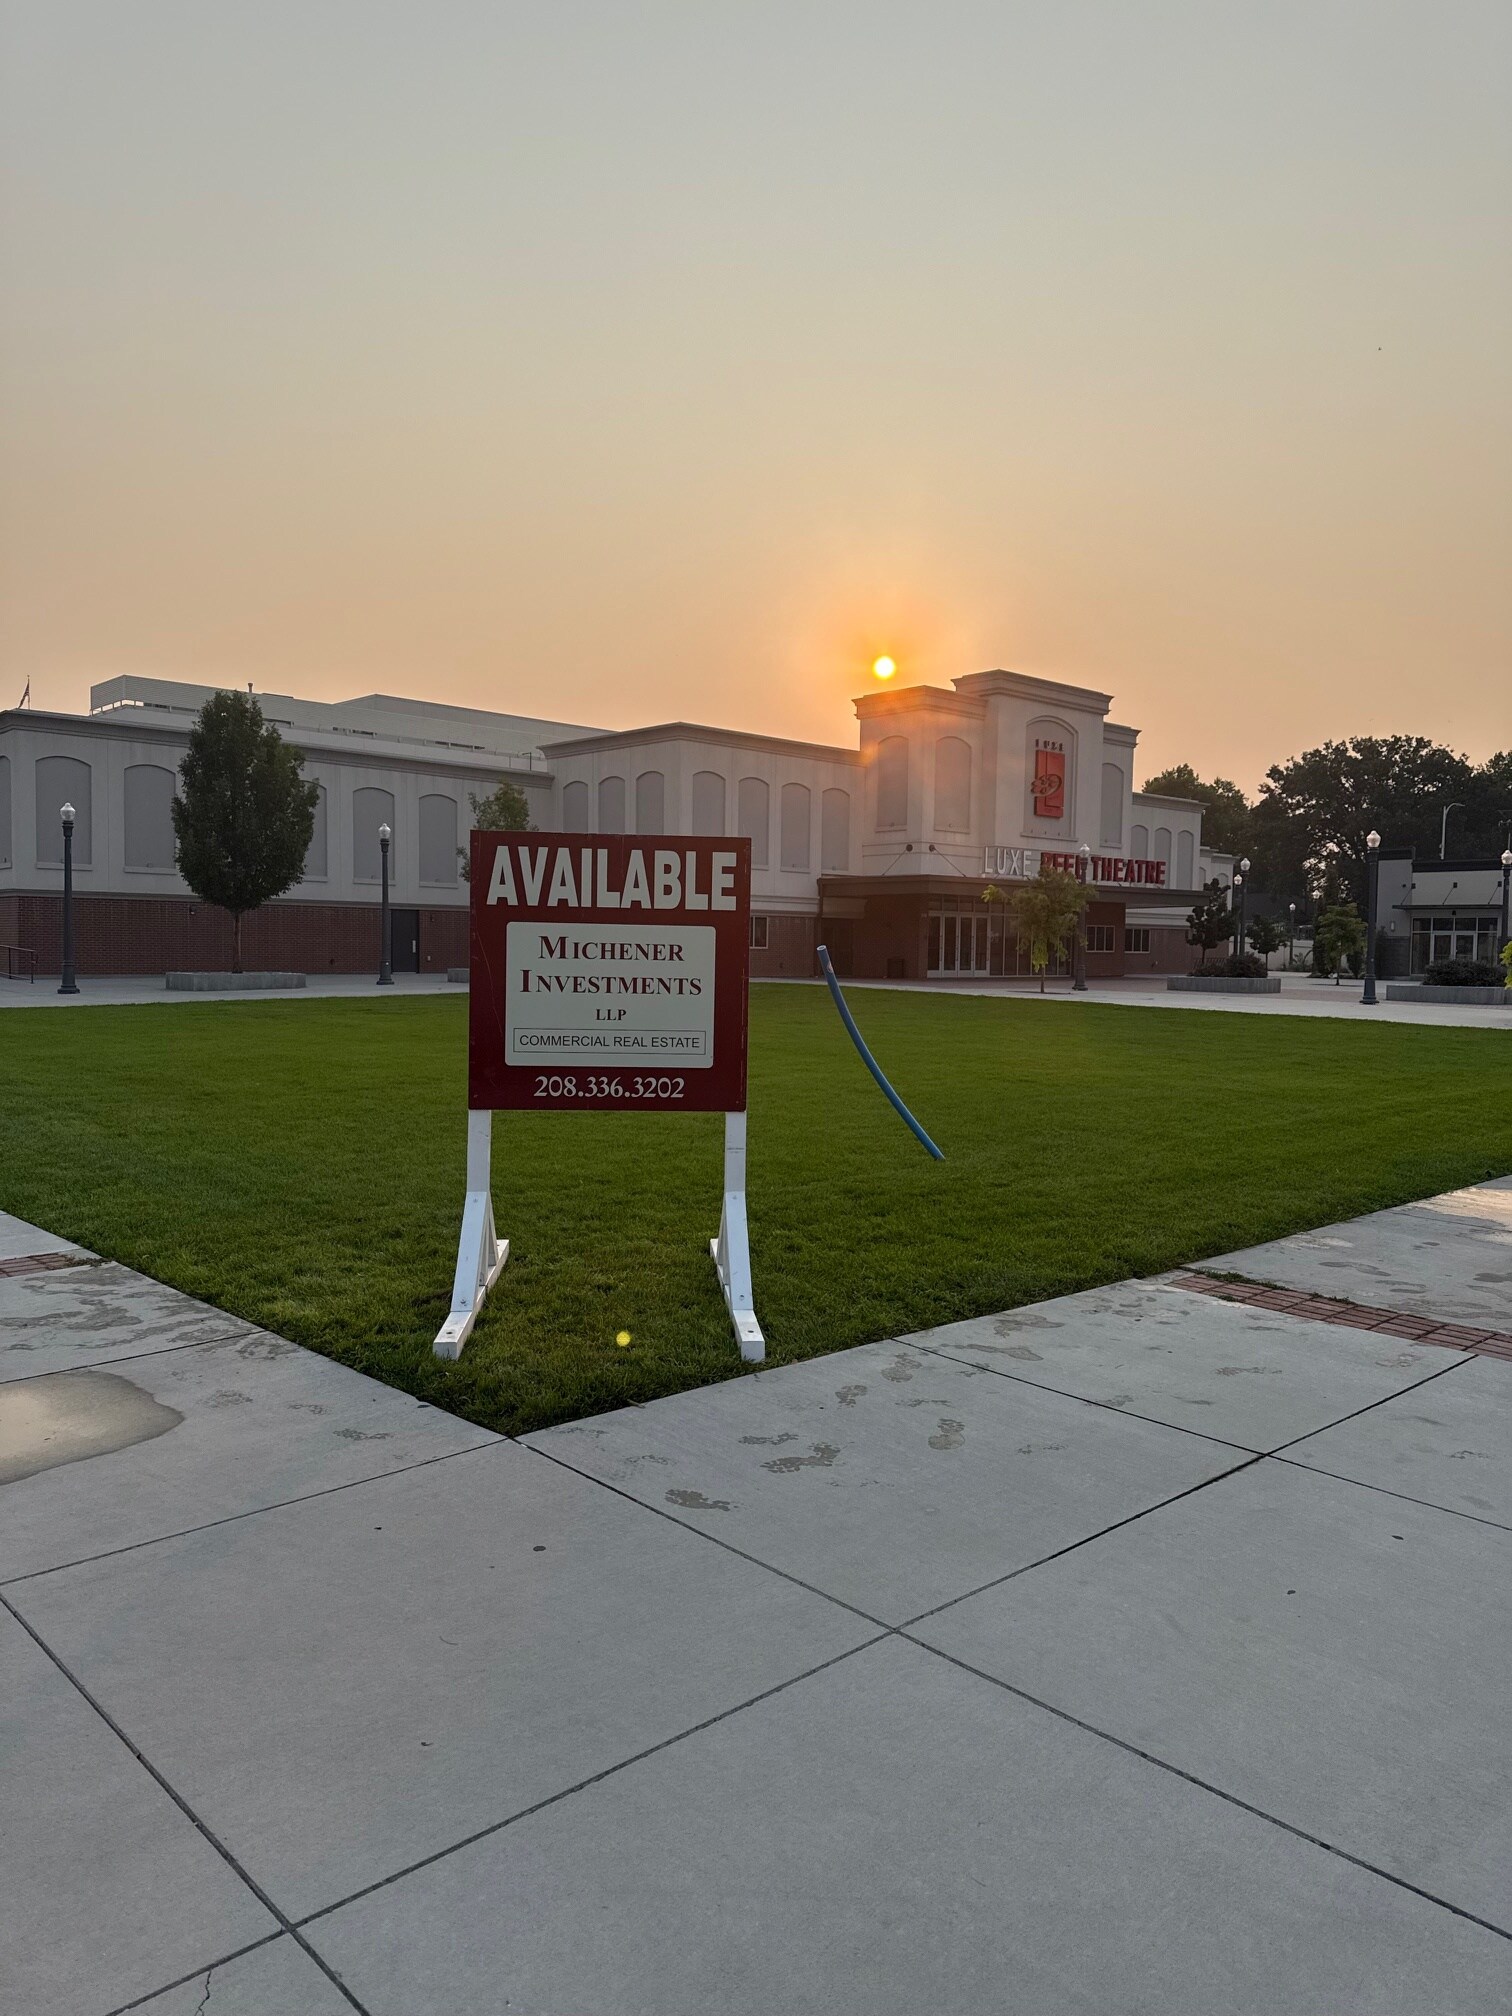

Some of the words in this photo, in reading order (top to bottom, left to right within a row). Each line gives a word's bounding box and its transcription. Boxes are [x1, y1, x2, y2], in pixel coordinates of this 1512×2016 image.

[486, 845, 737, 911] AVAILABLE
[984, 847, 1032, 876] LUXE
[1091, 856, 1166, 885] THEATRE
[538, 935, 685, 961] MICHENER
[519, 969, 702, 995] INVESTMENTS
[595, 1009, 627, 1021] LLP
[519, 1034, 610, 1047] COMMERCIAL
[613, 1036, 648, 1048] REAL
[651, 1037, 700, 1048] ESTATE
[534, 1075, 685, 1098] 208.336.3202
